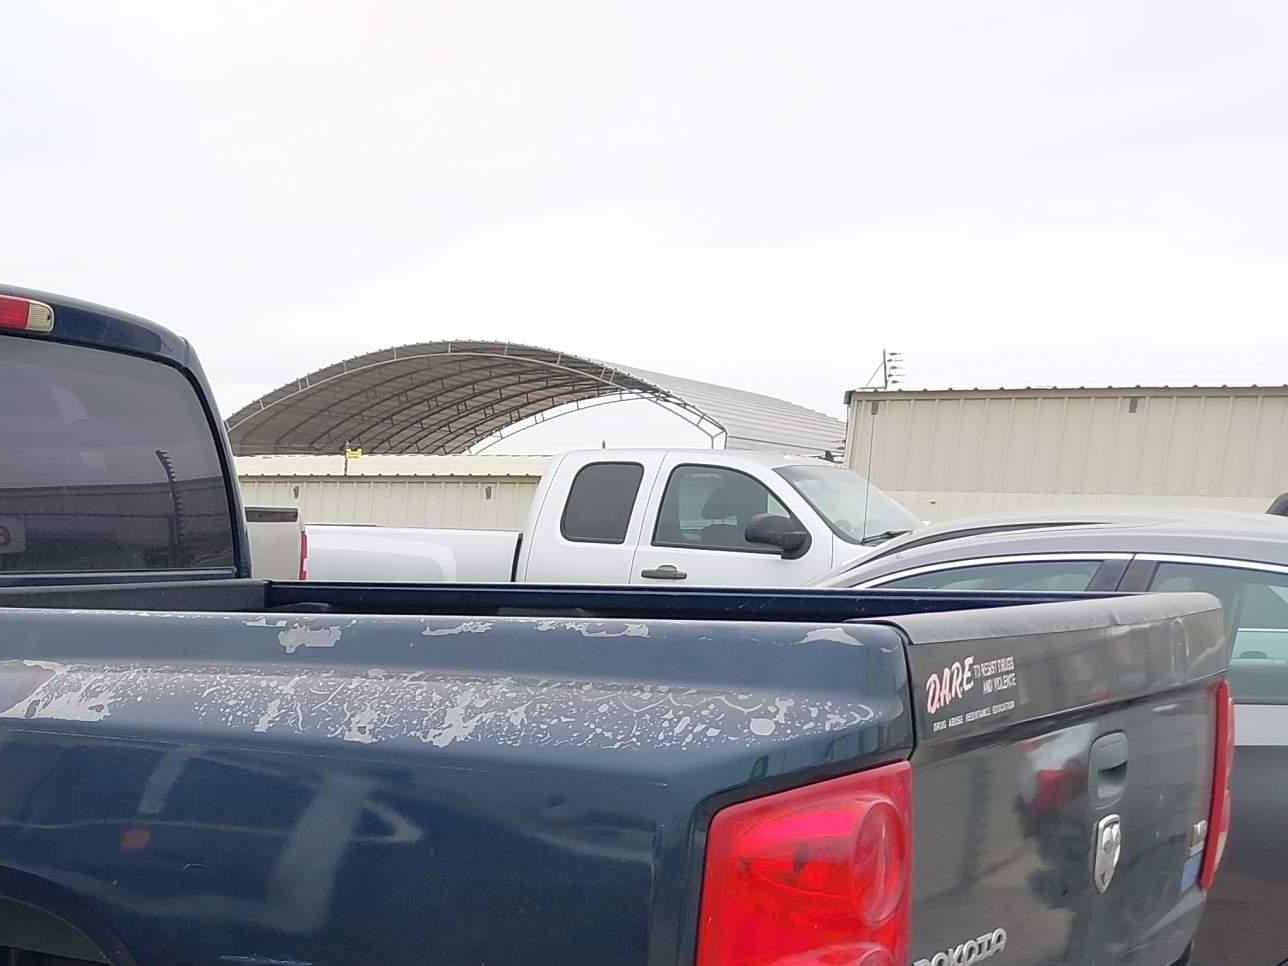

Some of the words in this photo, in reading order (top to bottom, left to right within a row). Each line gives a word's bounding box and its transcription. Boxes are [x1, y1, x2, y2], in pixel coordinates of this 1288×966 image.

[981, 661, 996, 677] RESIST
[998, 656, 1014, 672] DRUGS
[983, 679, 992, 694] AND
[994, 673, 1016, 691] VIOLENCE
[933, 720, 947, 732] DRUG
[949, 715, 962, 727] ABUSE
[965, 707, 991, 722] RESISTANCE
[992, 700, 1015, 714] EDUCATION
